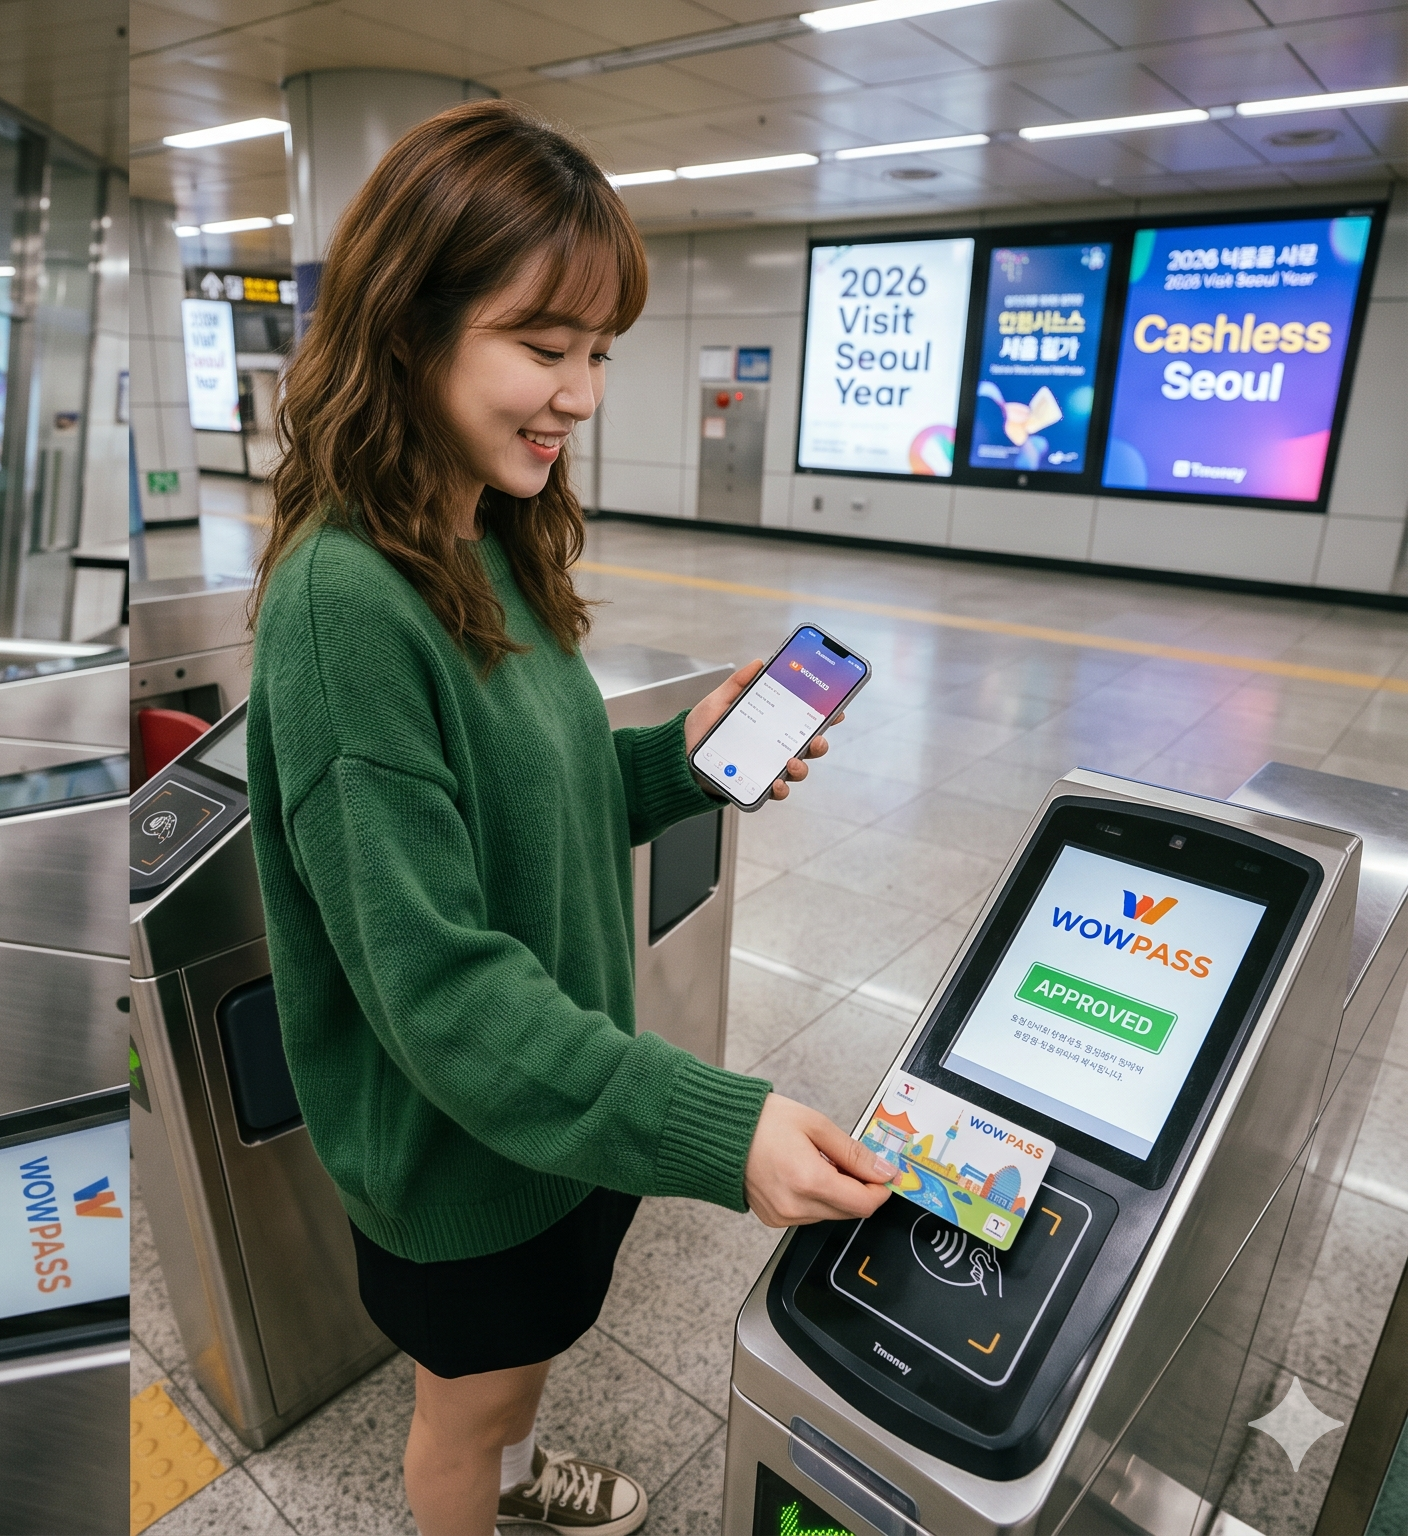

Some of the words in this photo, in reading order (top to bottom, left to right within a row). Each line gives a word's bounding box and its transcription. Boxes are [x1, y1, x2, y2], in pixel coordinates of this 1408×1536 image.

[1167, 248, 1219, 271] 2026
[840, 266, 928, 298] 2026
[1235, 270, 1280, 289] Seoul
[839, 304, 914, 334] Visit
[1133, 312, 1332, 354] Cashless
[836, 341, 931, 371] Seoul
[836, 378, 912, 407] Year
[1161, 360, 1285, 402] Seoul
[1052, 906, 1213, 979] WOWPASS
[1033, 979, 1154, 1036] APPROVED
[970, 1115, 1044, 1160] WOWPASS
[20, 1155, 72, 1293] WOWPASS
